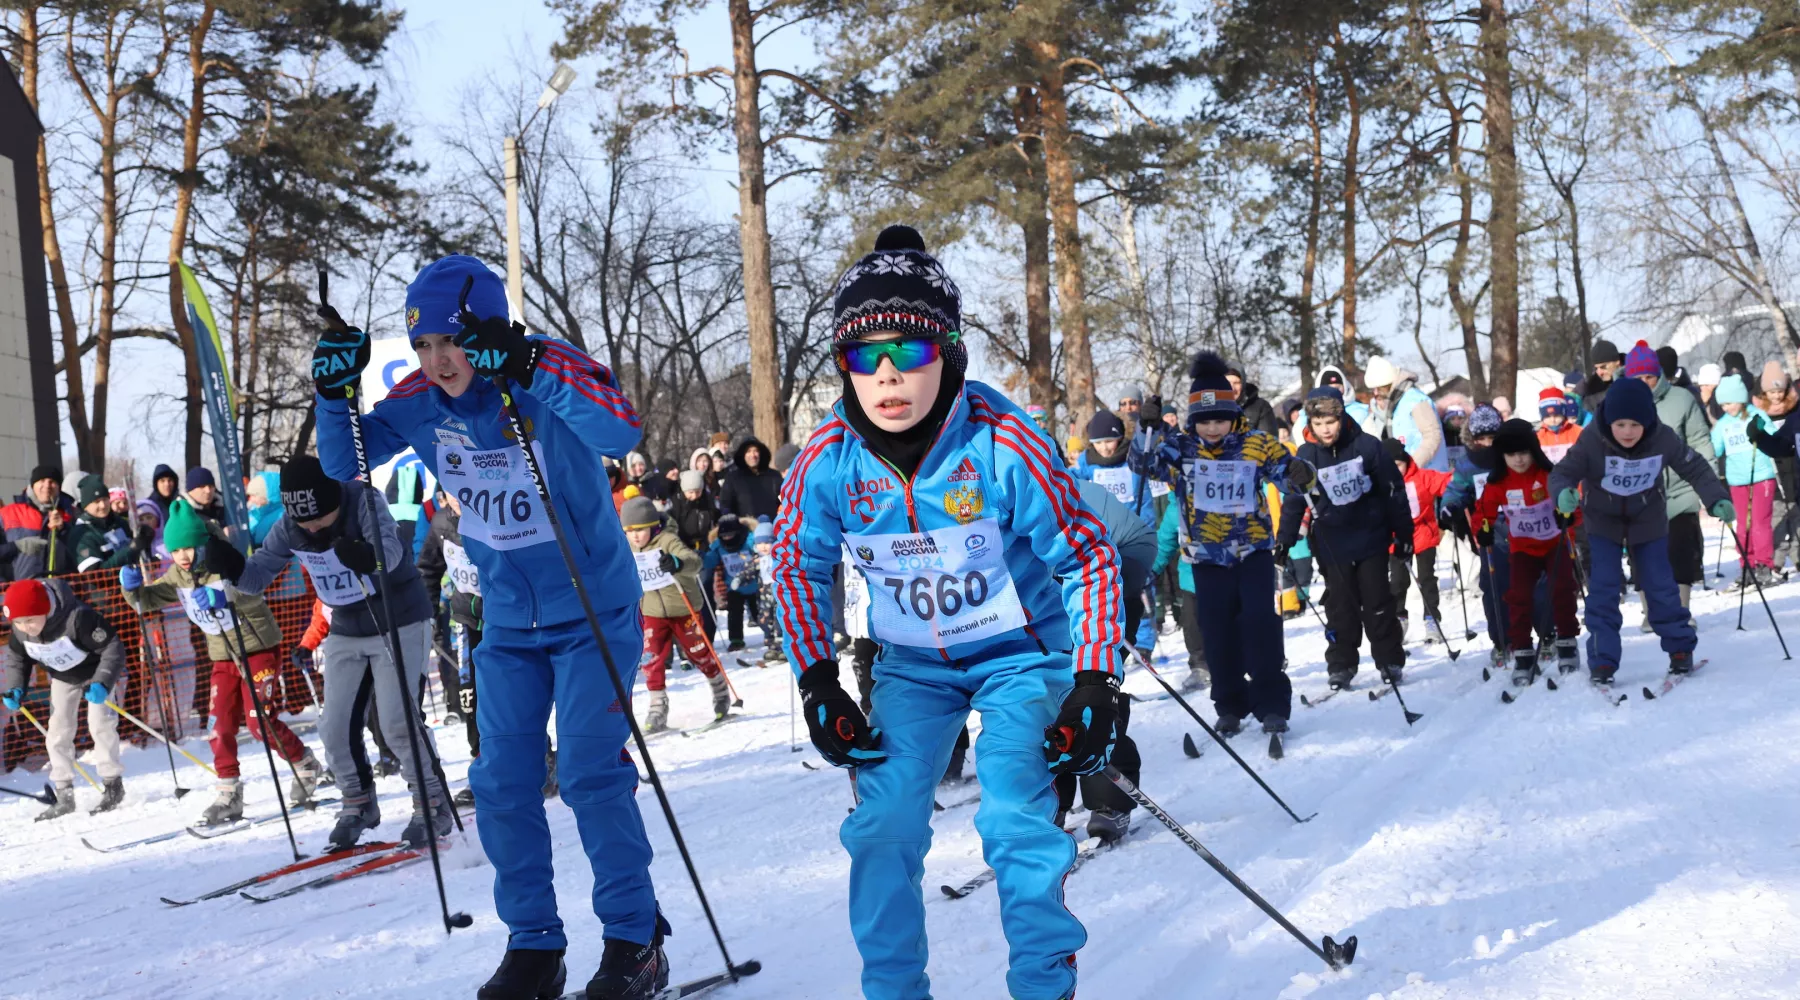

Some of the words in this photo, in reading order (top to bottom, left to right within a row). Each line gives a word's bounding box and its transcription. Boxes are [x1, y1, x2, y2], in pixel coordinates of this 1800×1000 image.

[312, 348, 358, 379] RAY
[464, 348, 508, 369] RAY
[348, 405, 370, 483] NORDWAY
[471, 452, 507, 462] ЛЫЖНЯ
[474, 459, 509, 469] РОССИИ
[478, 469, 510, 481] 2024
[947, 472, 981, 483] adidas
[1612, 472, 1651, 488] 6672
[1205, 481, 1246, 500] 6114
[1332, 474, 1365, 497] 6676
[286, 501, 319, 518] ACE
[522, 528, 538, 538] КРАЙ
[1517, 516, 1551, 533] 4978
[891, 537, 936, 550] ЛЫЖНЯ
[893, 546, 940, 558] РОССИИ
[899, 556, 944, 571] 2024
[312, 570, 353, 591] 727
[884, 570, 989, 622] 7660
[937, 620, 980, 638] АЛТАЙСКИЙ
[980, 612, 1000, 626] КРАЙ
[1130, 791, 1202, 852] MADSHUS
